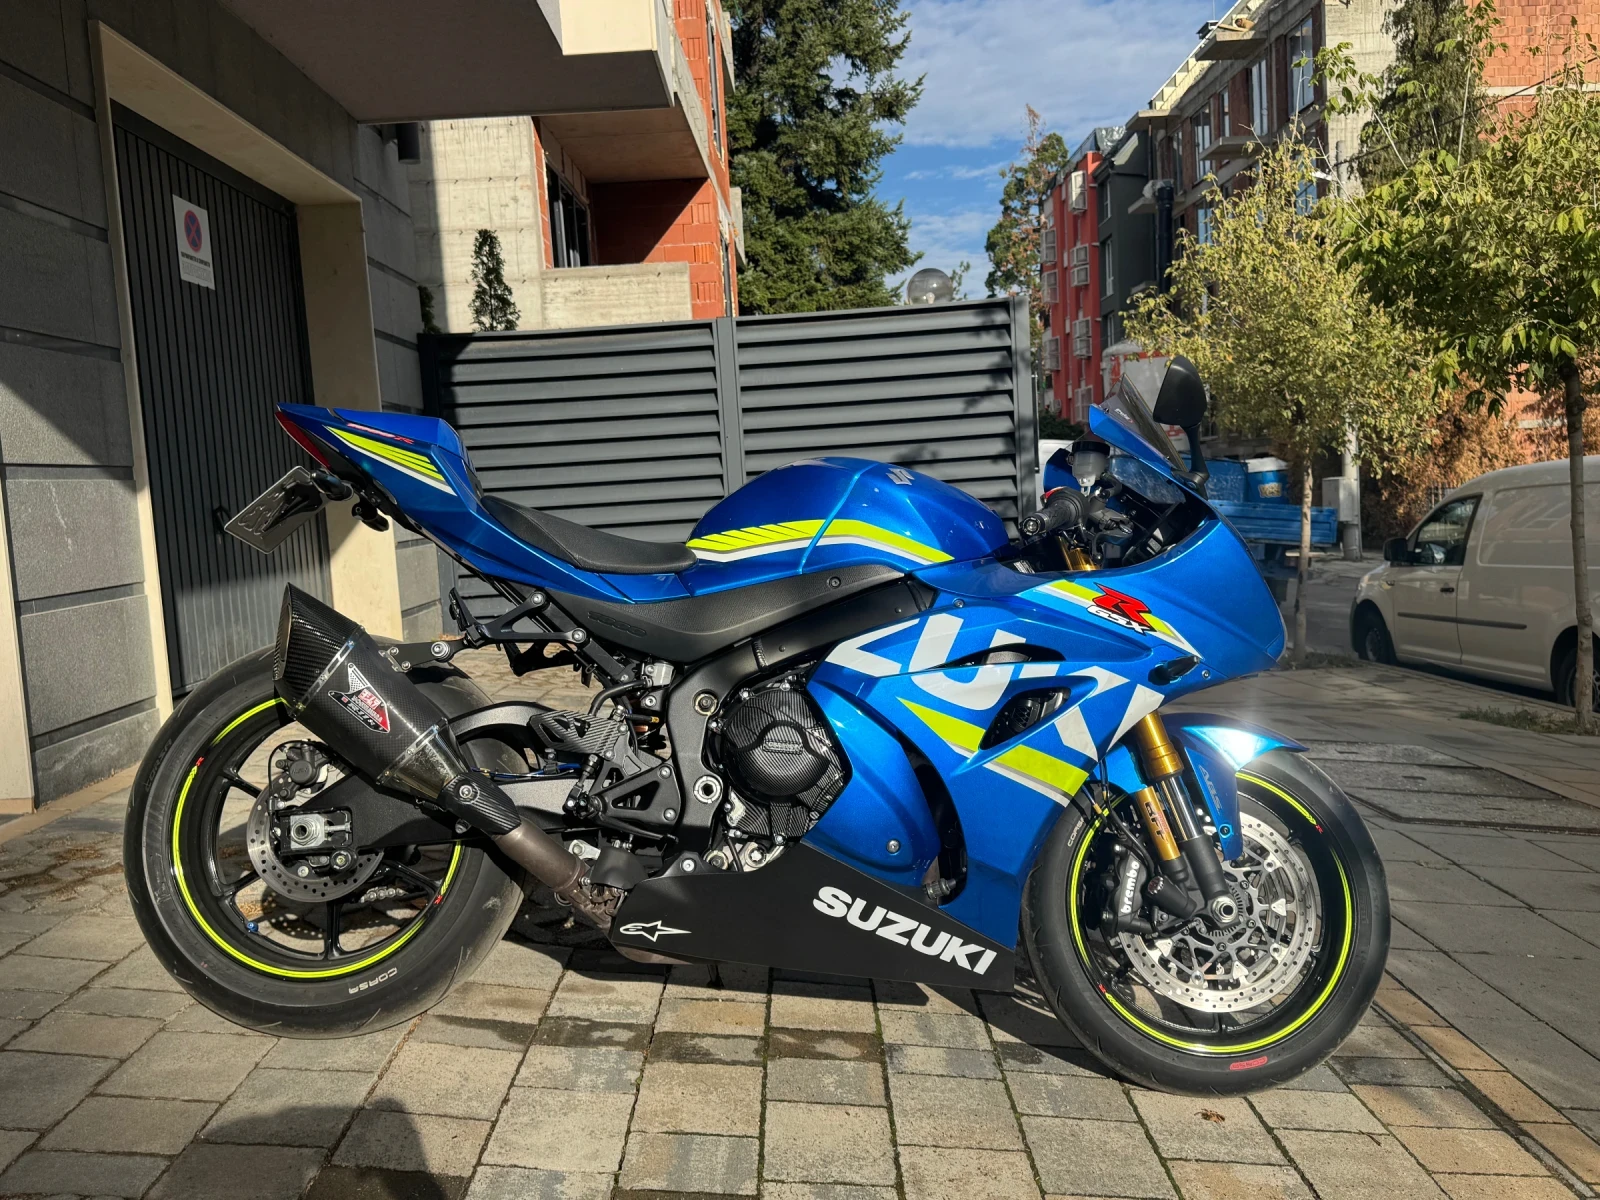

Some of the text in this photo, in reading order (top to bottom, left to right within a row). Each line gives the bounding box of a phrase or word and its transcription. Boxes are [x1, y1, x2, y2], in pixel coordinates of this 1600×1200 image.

[1086, 604, 1151, 634] GSX
[1119, 860, 1140, 914] brembo
[812, 885, 998, 976] SUZUKI
[348, 966, 398, 995] CORSA
